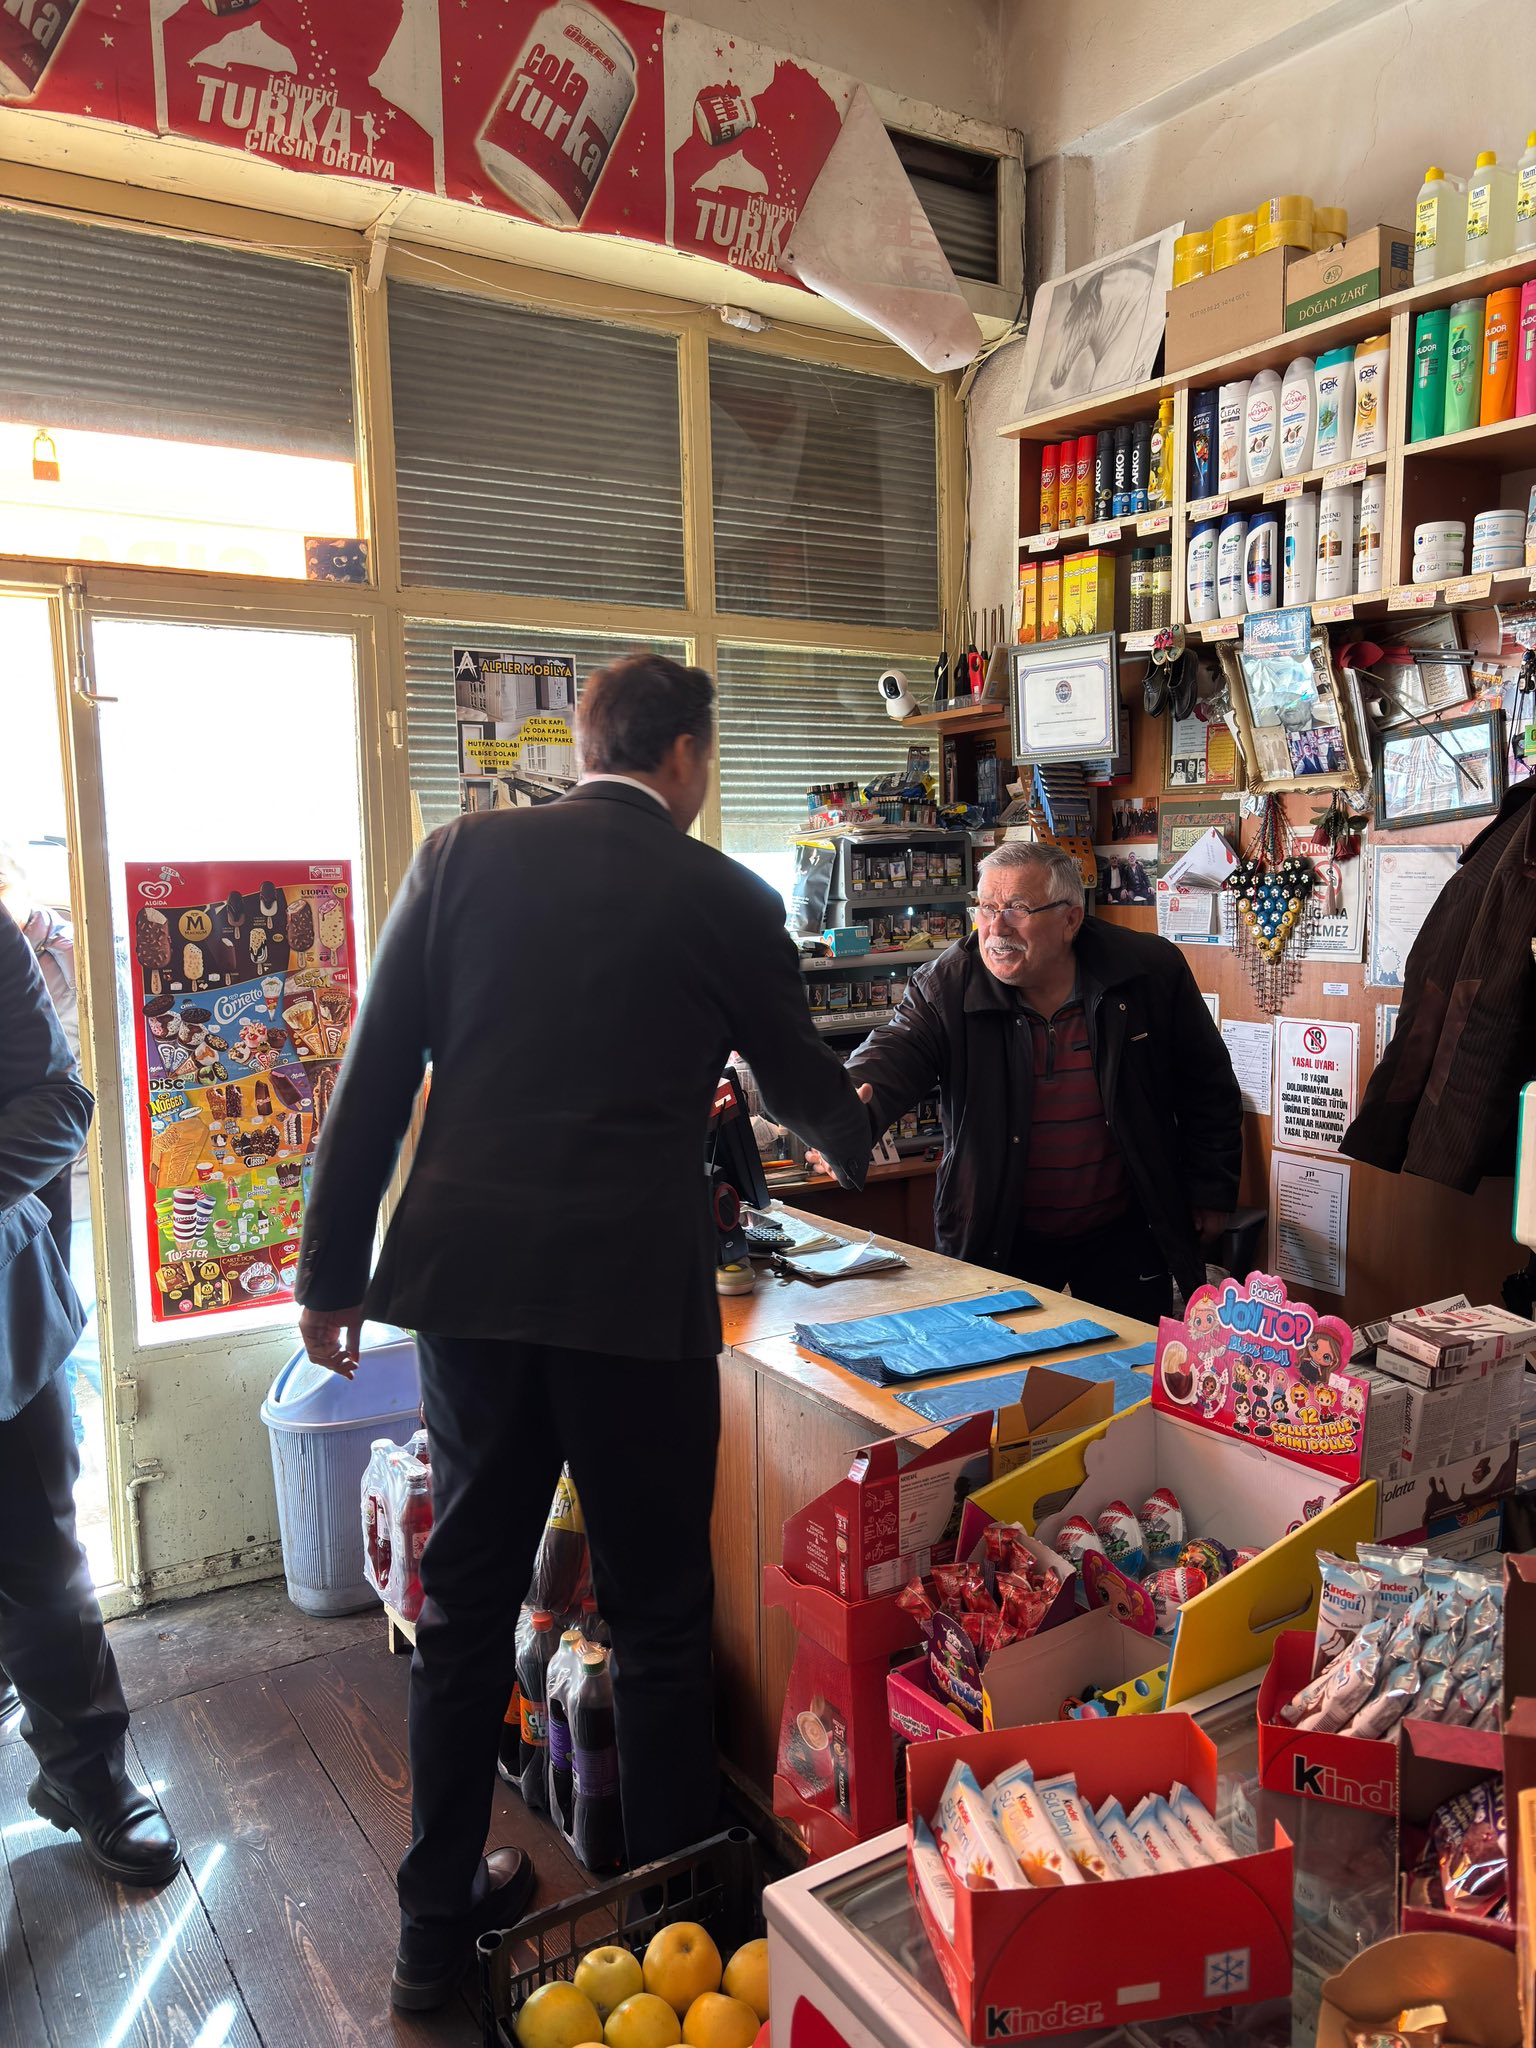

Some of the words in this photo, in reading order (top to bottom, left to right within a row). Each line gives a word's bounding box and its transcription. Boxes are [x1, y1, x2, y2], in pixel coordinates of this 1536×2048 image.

[525, 43, 589, 97] Cola
[196, 75, 352, 152] TURKA
[505, 73, 602, 182] Turka
[323, 147, 396, 181] ORTAYA
[695, 199, 789, 258] TURK
[1299, 297, 1338, 321] DOĞAN
[1340, 283, 1368, 307] ZARF
[1193, 417, 1210, 427] CLEAR
[1220, 408, 1241, 418] CLEAR
[1115, 454, 1125, 488] ARKO
[1131, 450, 1140, 485] ARKO
[481, 660, 522, 675] ALPLER
[524, 662, 573, 677] MOBİLYA
[467, 740, 494, 748] MUTFAK
[495, 741, 520, 749] DOLABI
[554, 736, 573, 744] PARKE
[333, 885, 348, 894] YENİ
[213, 988, 263, 1025] Cornetto
[1291, 1056, 1313, 1069] YASAL
[1314, 1059, 1335, 1071] UYARI
[1301, 1073, 1308, 1081] 18
[1309, 1074, 1329, 1086] YAŞINI
[1286, 1082, 1343, 1098] DOLDURMAYANLARA
[151, 1096, 185, 1115] NOGGER
[1281, 1090, 1302, 1104] SİGARA
[1303, 1096, 1310, 1105] VE
[1311, 1095, 1327, 1108] DİĞER
[1329, 1097, 1348, 1110] TÜTÜN
[1283, 1103, 1310, 1116] ÜRÜNLERİ
[1285, 1115, 1314, 1128] SATANLAR
[1315, 1119, 1344, 1132] HAKKINDA
[1284, 1126, 1301, 1138] YASAL
[1302, 1128, 1320, 1141] İŞLEM
[1250, 1281, 1283, 1304] Bonart
[1299, 1407, 1319, 1424] 12
[1405, 1393, 1413, 1435] Biscolata
[1271, 1418, 1354, 1437] COLLECTIBLE
[1274, 1433, 1307, 1451] MINI
[1309, 1436, 1355, 1454] DOLLS
[1323, 1579, 1357, 1600] kinder
[1380, 1582, 1408, 1592] inder
[1293, 1754, 1397, 1812] kind
[985, 2000, 1104, 2039] kinder
